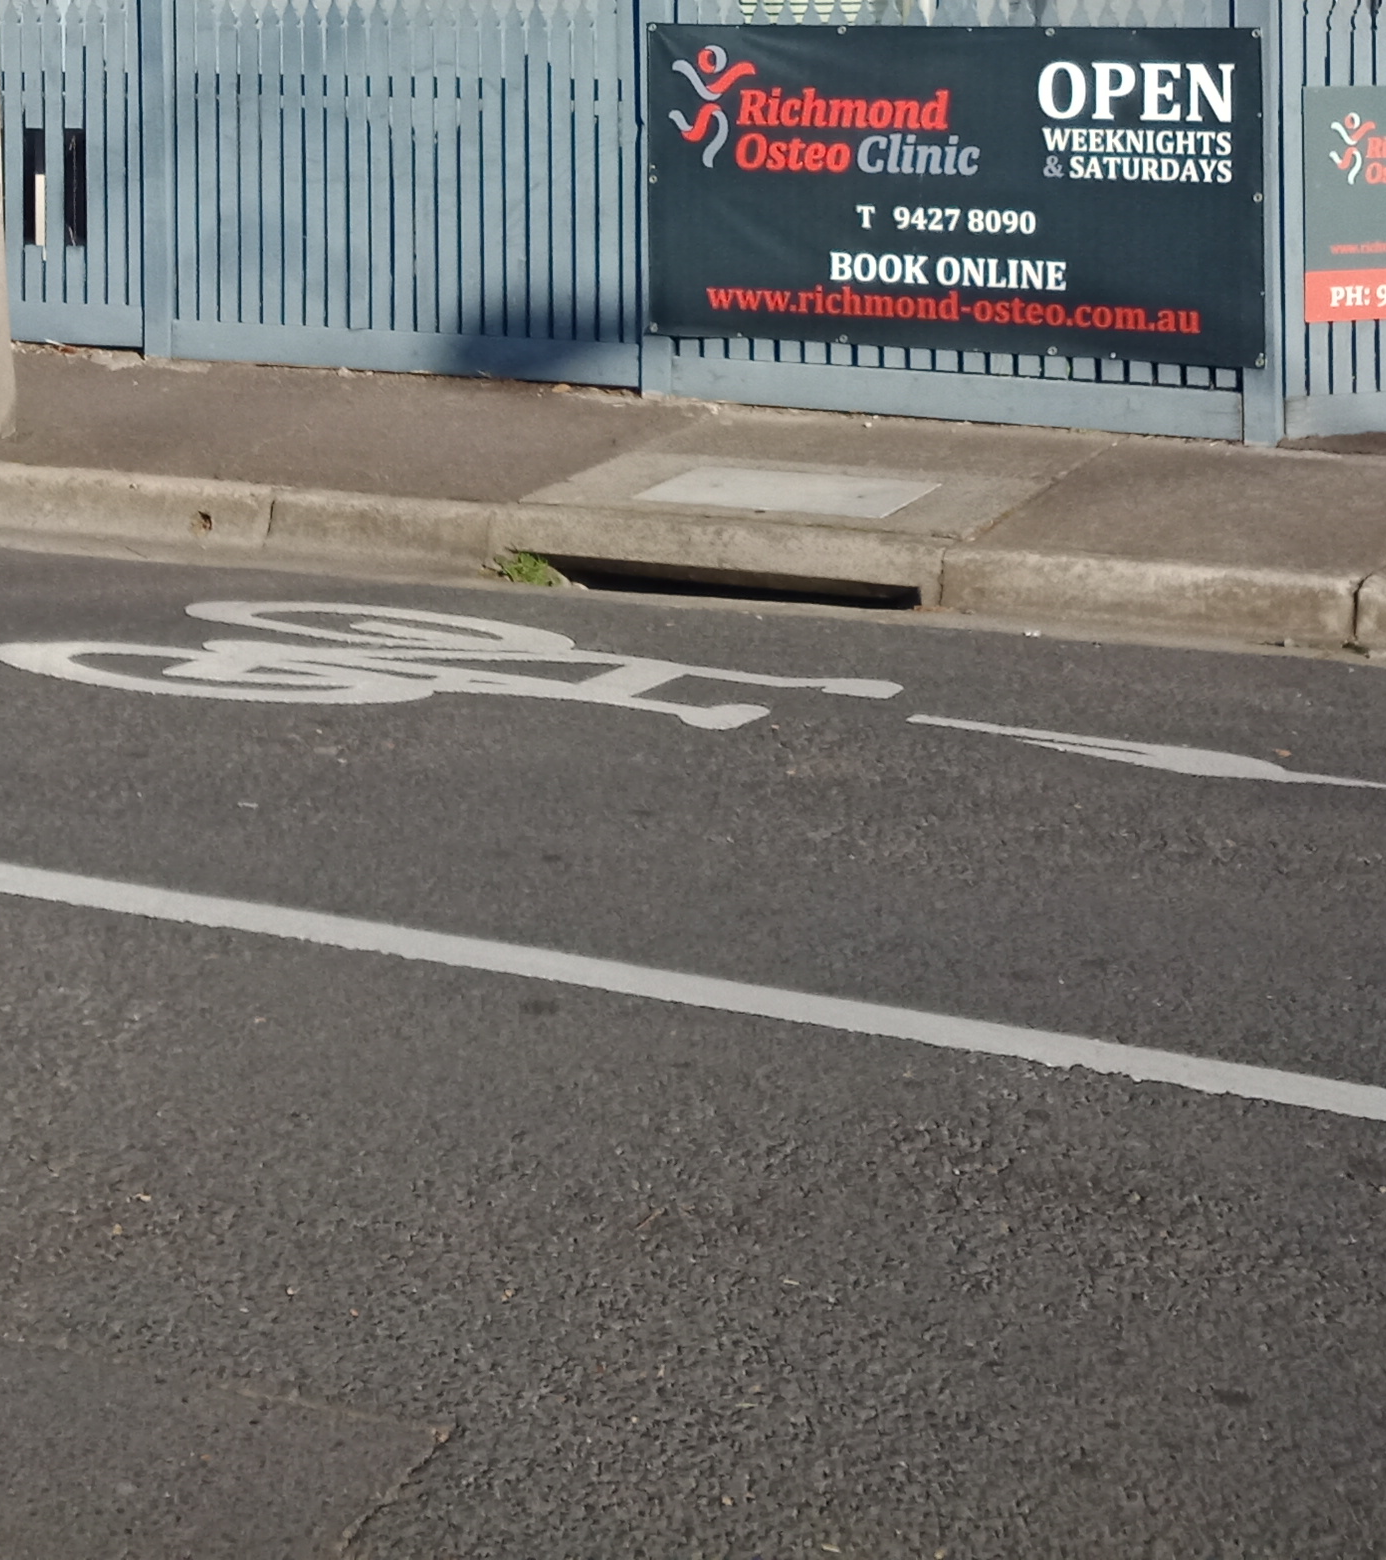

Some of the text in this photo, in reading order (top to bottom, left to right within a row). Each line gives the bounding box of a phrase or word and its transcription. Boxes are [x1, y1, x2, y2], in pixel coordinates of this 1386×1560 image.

[737, 87, 949, 131] Richmond
[1038, 61, 1236, 124] OPEN
[735, 133, 981, 177] Osteo Clinic
[1042, 127, 1232, 157] WEEKNIGHTS
[1043, 156, 1233, 184] & SATURDAYS
[856, 205, 1037, 236] T 9427 8090
[830, 251, 1067, 292] BOOK ONLINE
[707, 286, 1201, 335] www.richmond-osteo.com.au
[1330, 285, 1370, 307] PH:
